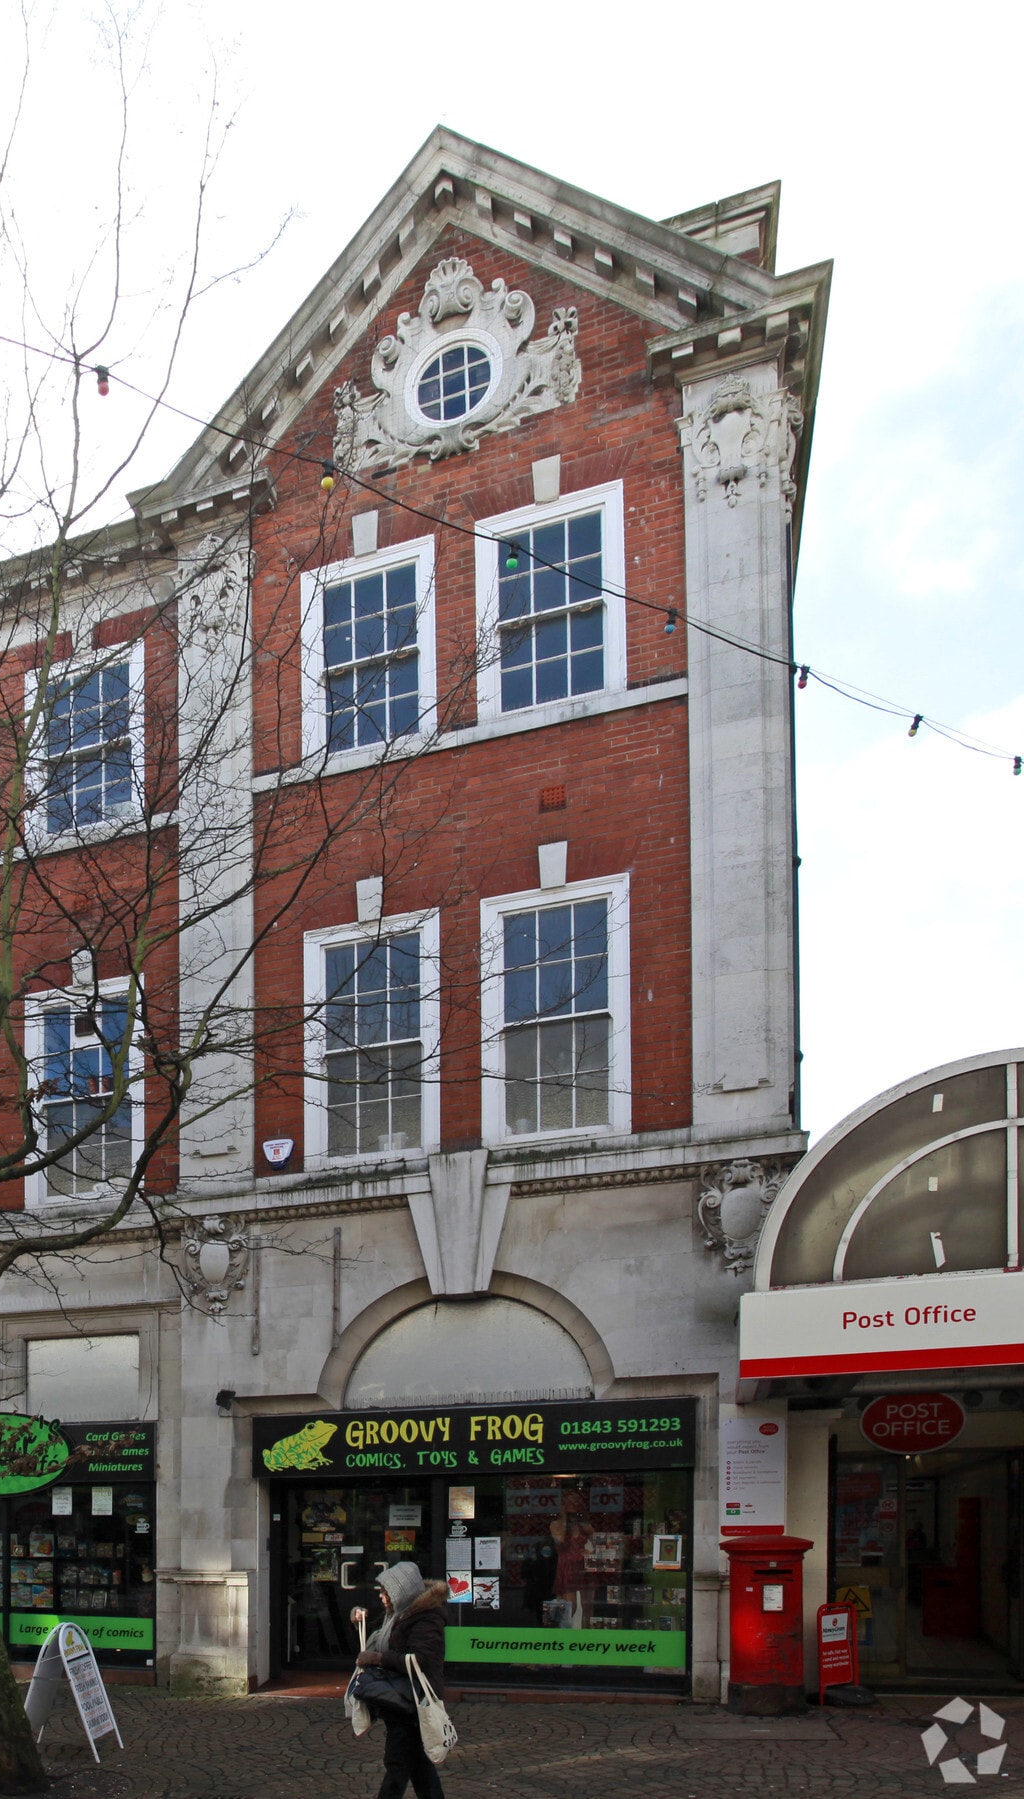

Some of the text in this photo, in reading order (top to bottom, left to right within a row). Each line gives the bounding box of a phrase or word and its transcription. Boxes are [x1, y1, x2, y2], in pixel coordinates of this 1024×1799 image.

[843, 1305, 977, 1330] Post Office
[887, 1403, 943, 1420] POST
[346, 1414, 544, 1450] GROOVY FROG
[560, 1418, 681, 1435] 01843 591293
[873, 1420, 951, 1438] OFFICE
[86, 1432, 109, 1442] Card
[558, 1438, 684, 1452] www.groovyfrog.co.uk
[119, 1447, 150, 1456] ames
[346, 1448, 545, 1469] COMICS, TOYS & GAMES
[88, 1463, 143, 1472] Miniatures
[387, 1544, 413, 1552] OPEN
[20, 1624, 49, 1636] Large
[93, 1627, 105, 1639] of
[106, 1627, 145, 1638] comics
[470, 1638, 657, 1654] Tournaments every week
